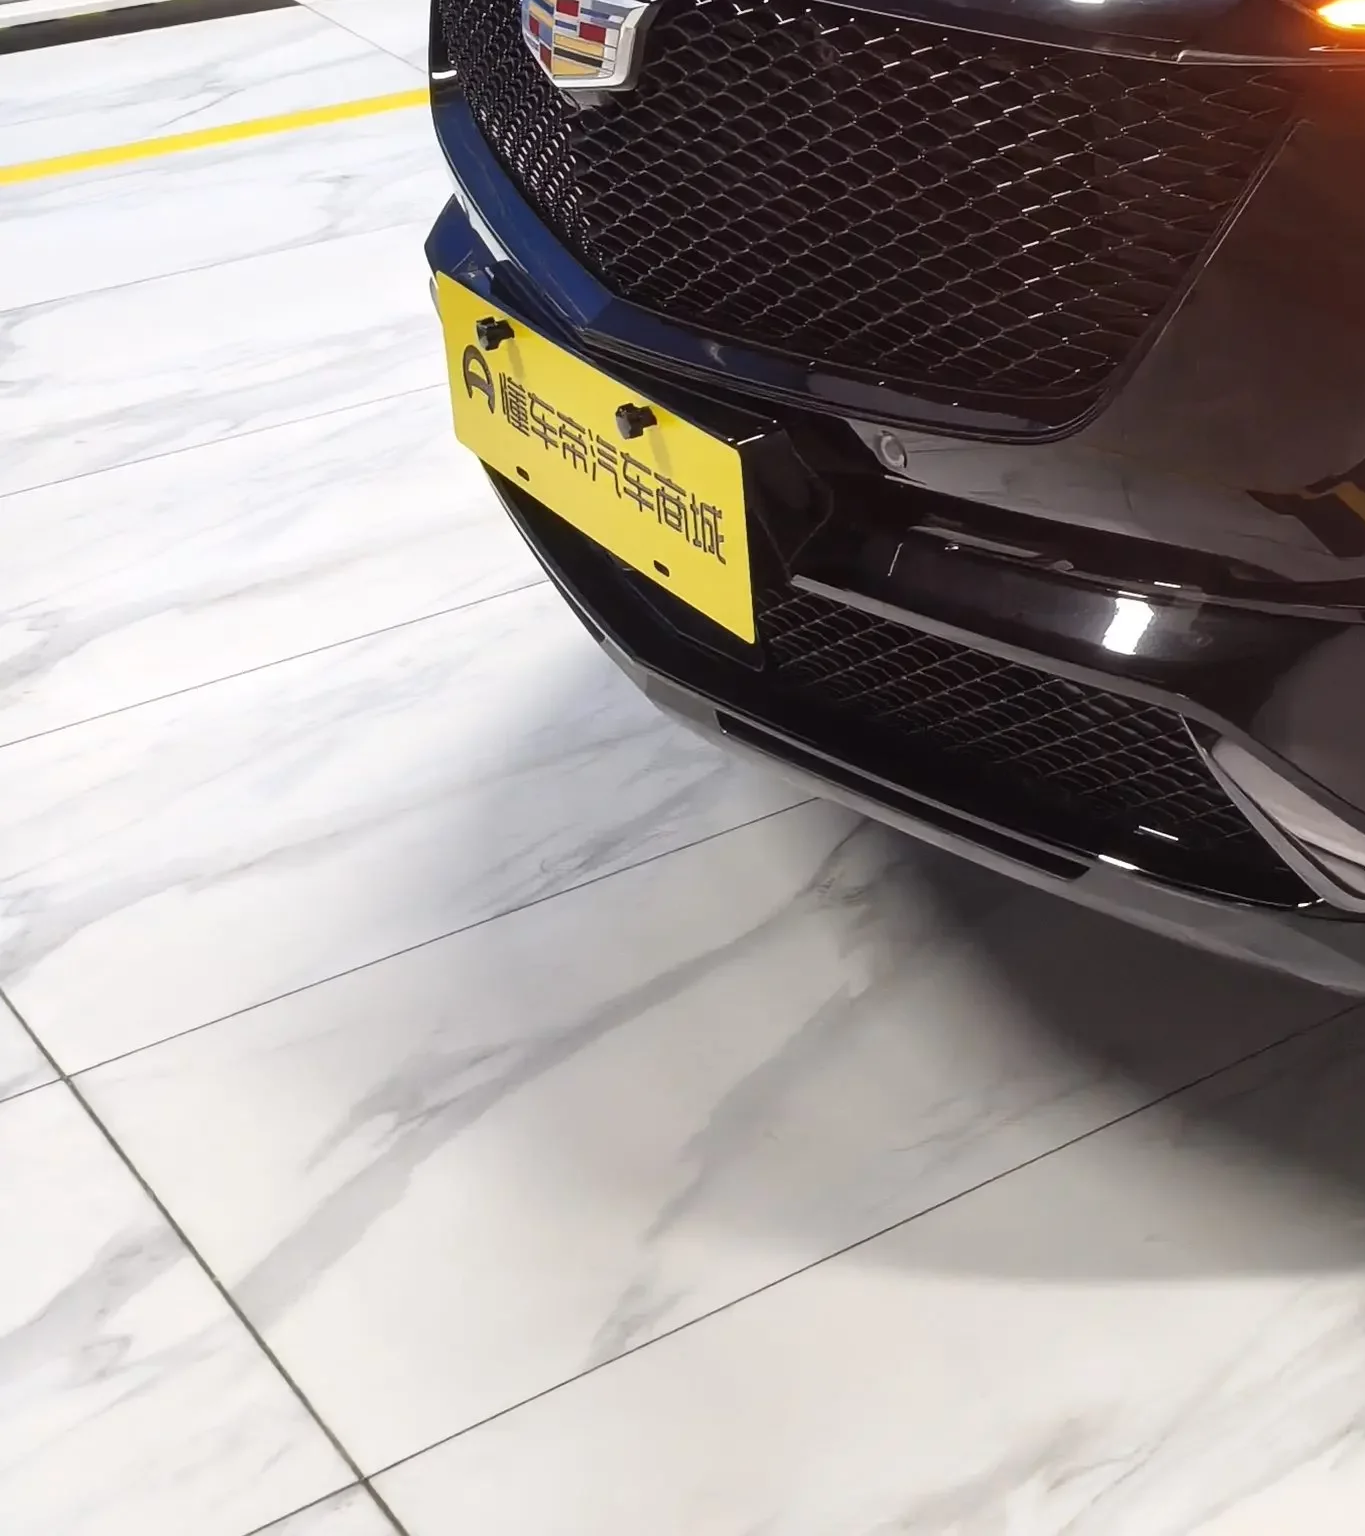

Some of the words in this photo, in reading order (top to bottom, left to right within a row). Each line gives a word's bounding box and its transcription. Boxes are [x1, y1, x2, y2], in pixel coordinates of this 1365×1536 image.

[499, 371, 727, 566] 懂车帝汽车商城
